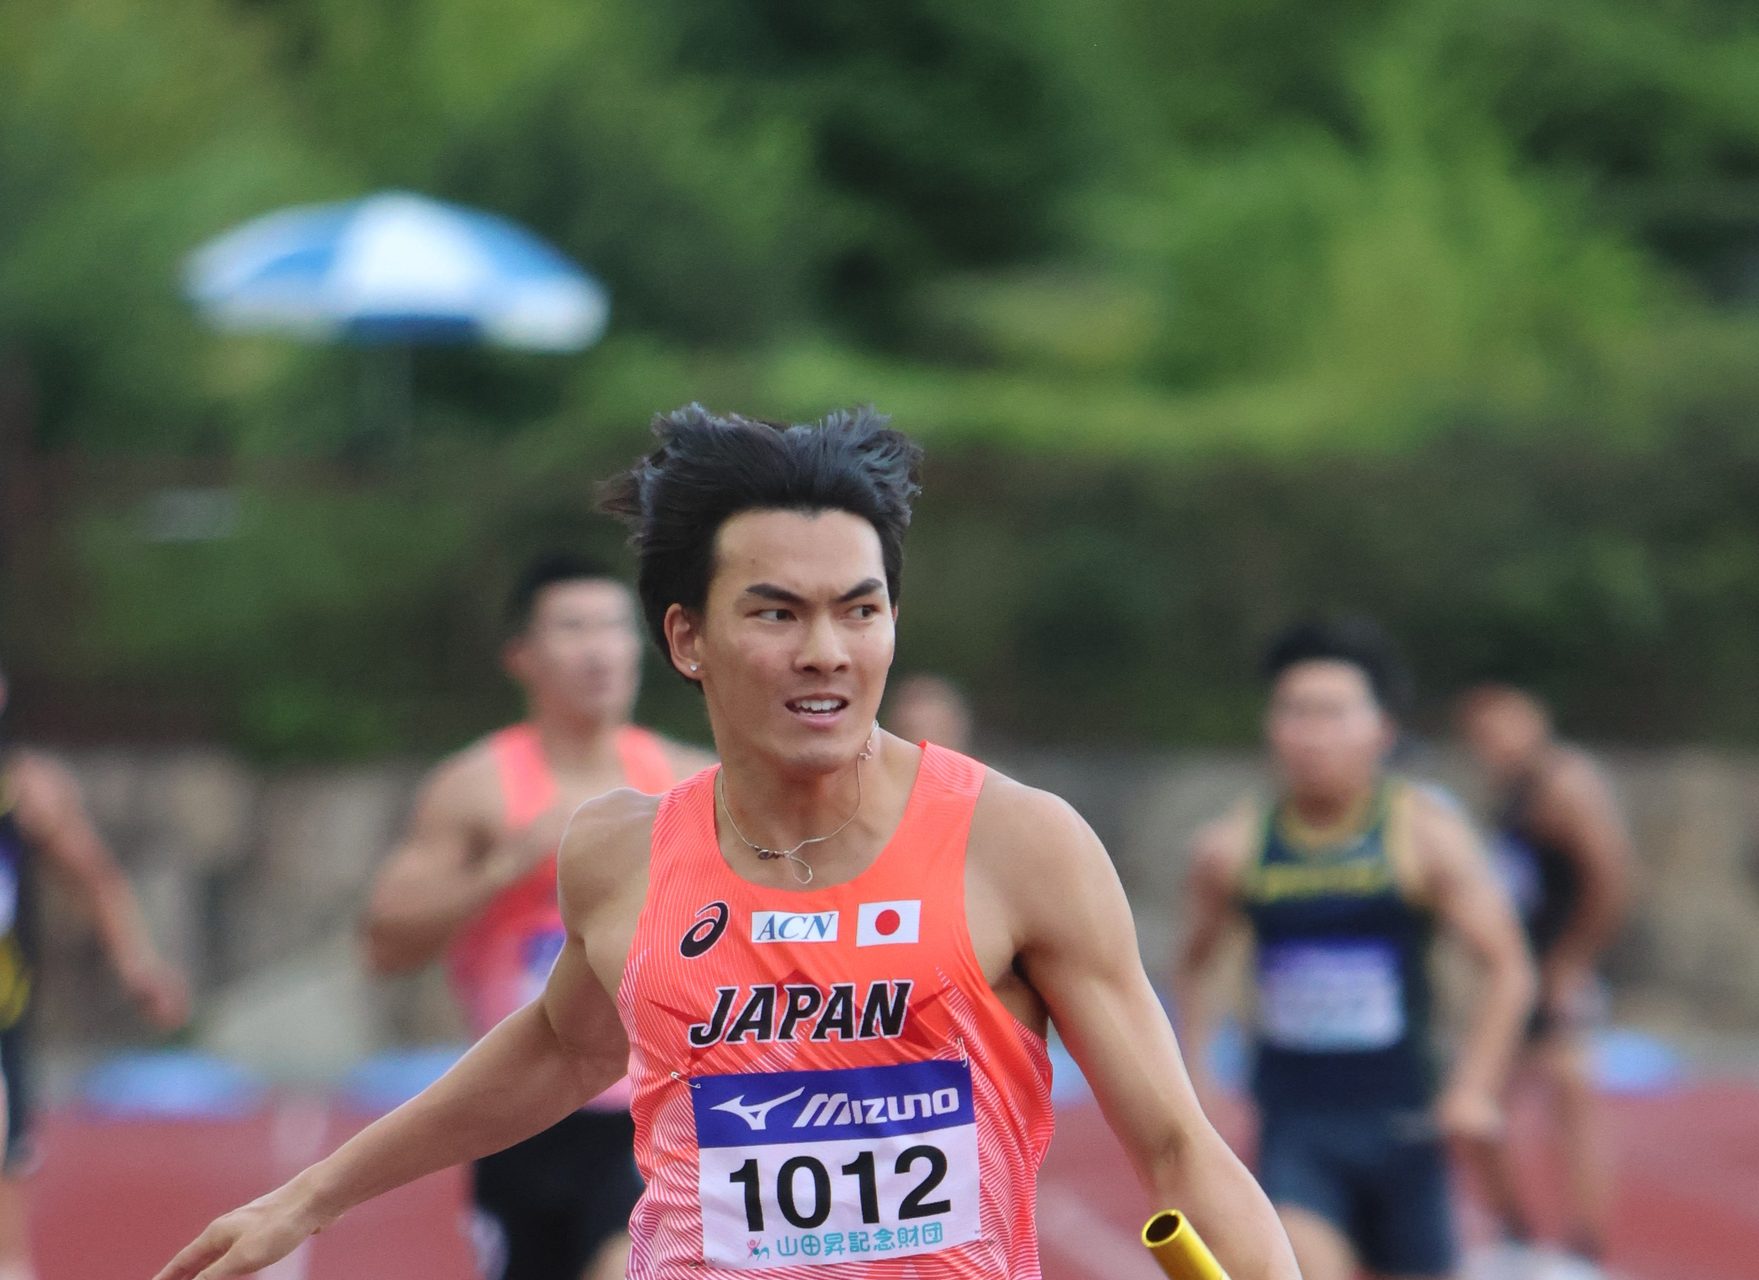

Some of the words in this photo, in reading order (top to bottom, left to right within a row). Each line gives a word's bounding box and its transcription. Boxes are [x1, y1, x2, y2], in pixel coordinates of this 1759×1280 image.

[756, 913, 835, 940] ACN
[689, 980, 913, 1047] JAPAN
[729, 1145, 951, 1232] 1012
[777, 1221, 943, 1257] 山田昇記念財団
